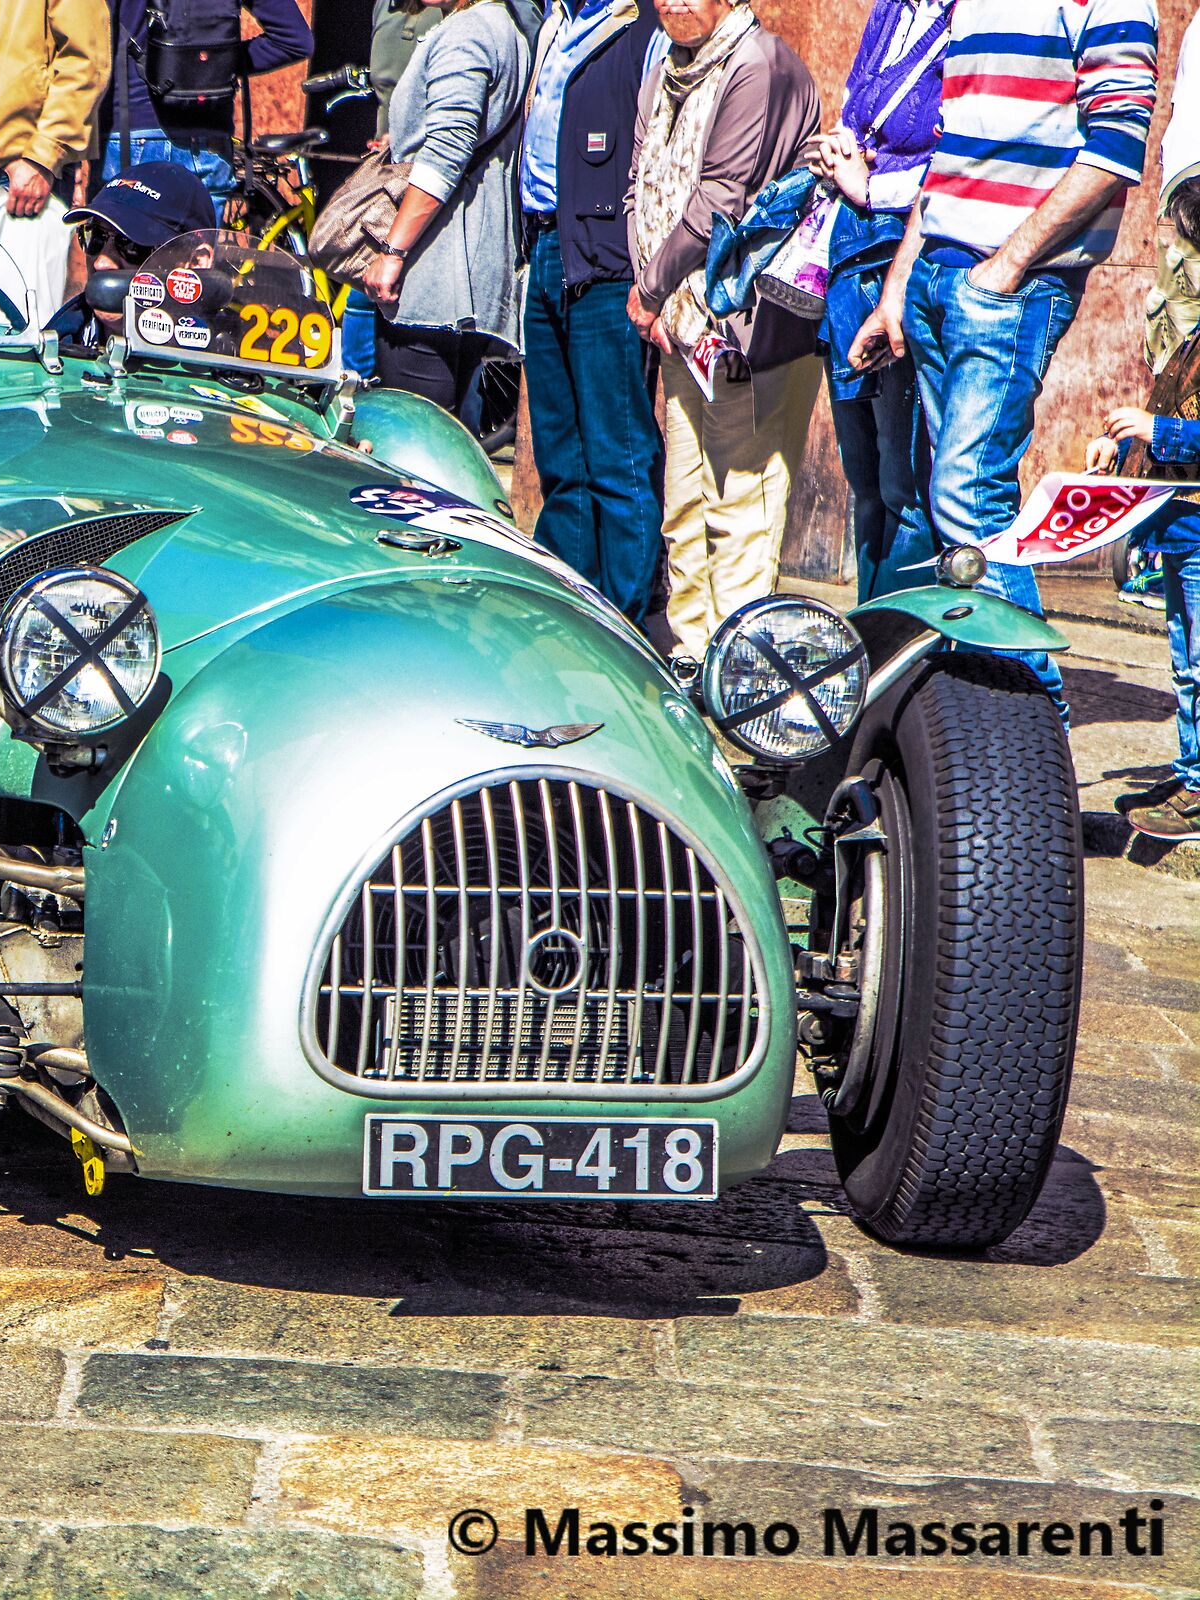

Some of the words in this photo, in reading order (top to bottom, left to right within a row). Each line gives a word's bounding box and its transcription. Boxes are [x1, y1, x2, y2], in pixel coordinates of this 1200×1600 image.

[133, 181, 161, 200] Banca
[132, 285, 163, 299] VERIFICATO
[173, 281, 196, 293] 2015
[142, 319, 171, 333] VERIFICATO
[178, 330, 208, 341] VERIFICATO
[240, 303, 332, 369] 229
[1038, 486, 1100, 540] 100
[379, 1122, 704, 1193] RPG-418
